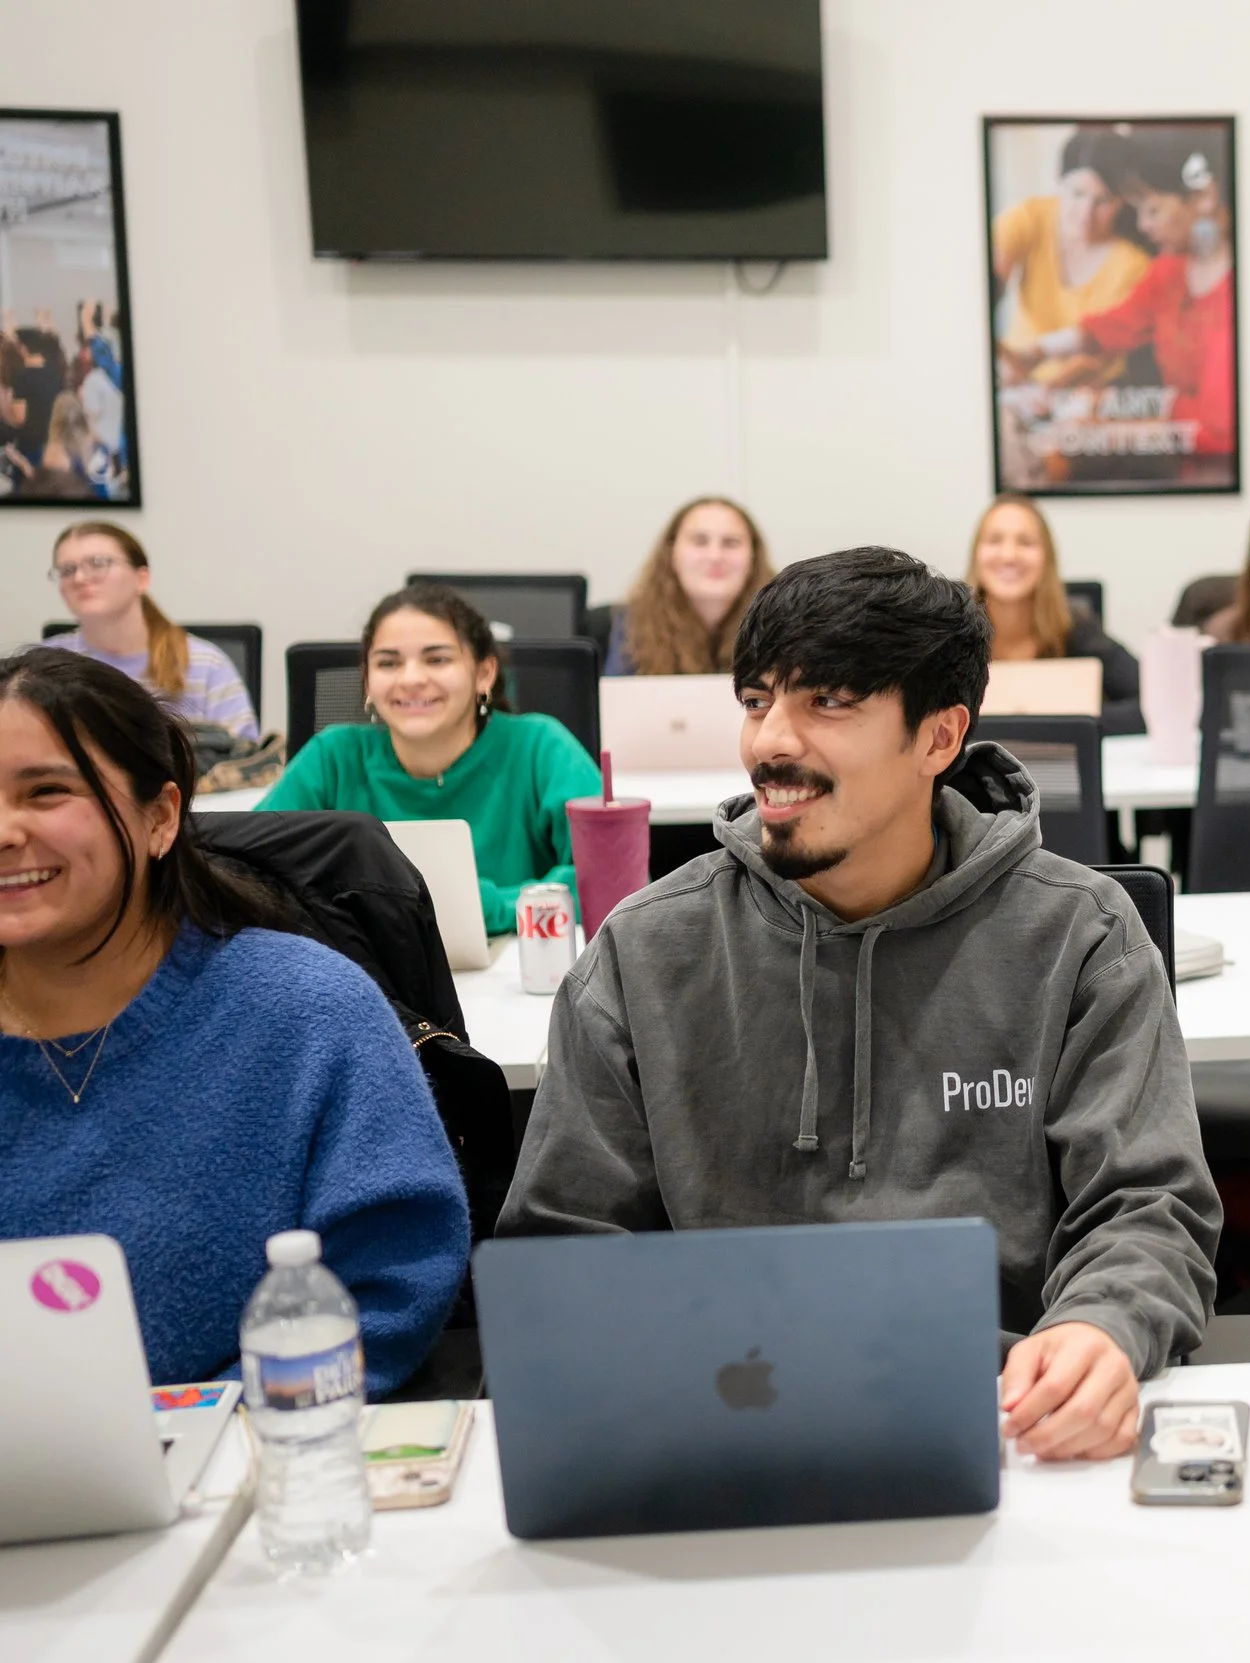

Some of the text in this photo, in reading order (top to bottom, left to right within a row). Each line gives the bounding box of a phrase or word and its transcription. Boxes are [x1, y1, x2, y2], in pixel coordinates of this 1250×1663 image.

[1098, 385, 1178, 420] ANY
[1028, 419, 1201, 457] CONTEXT
[943, 1069, 1035, 1112] ProDev
